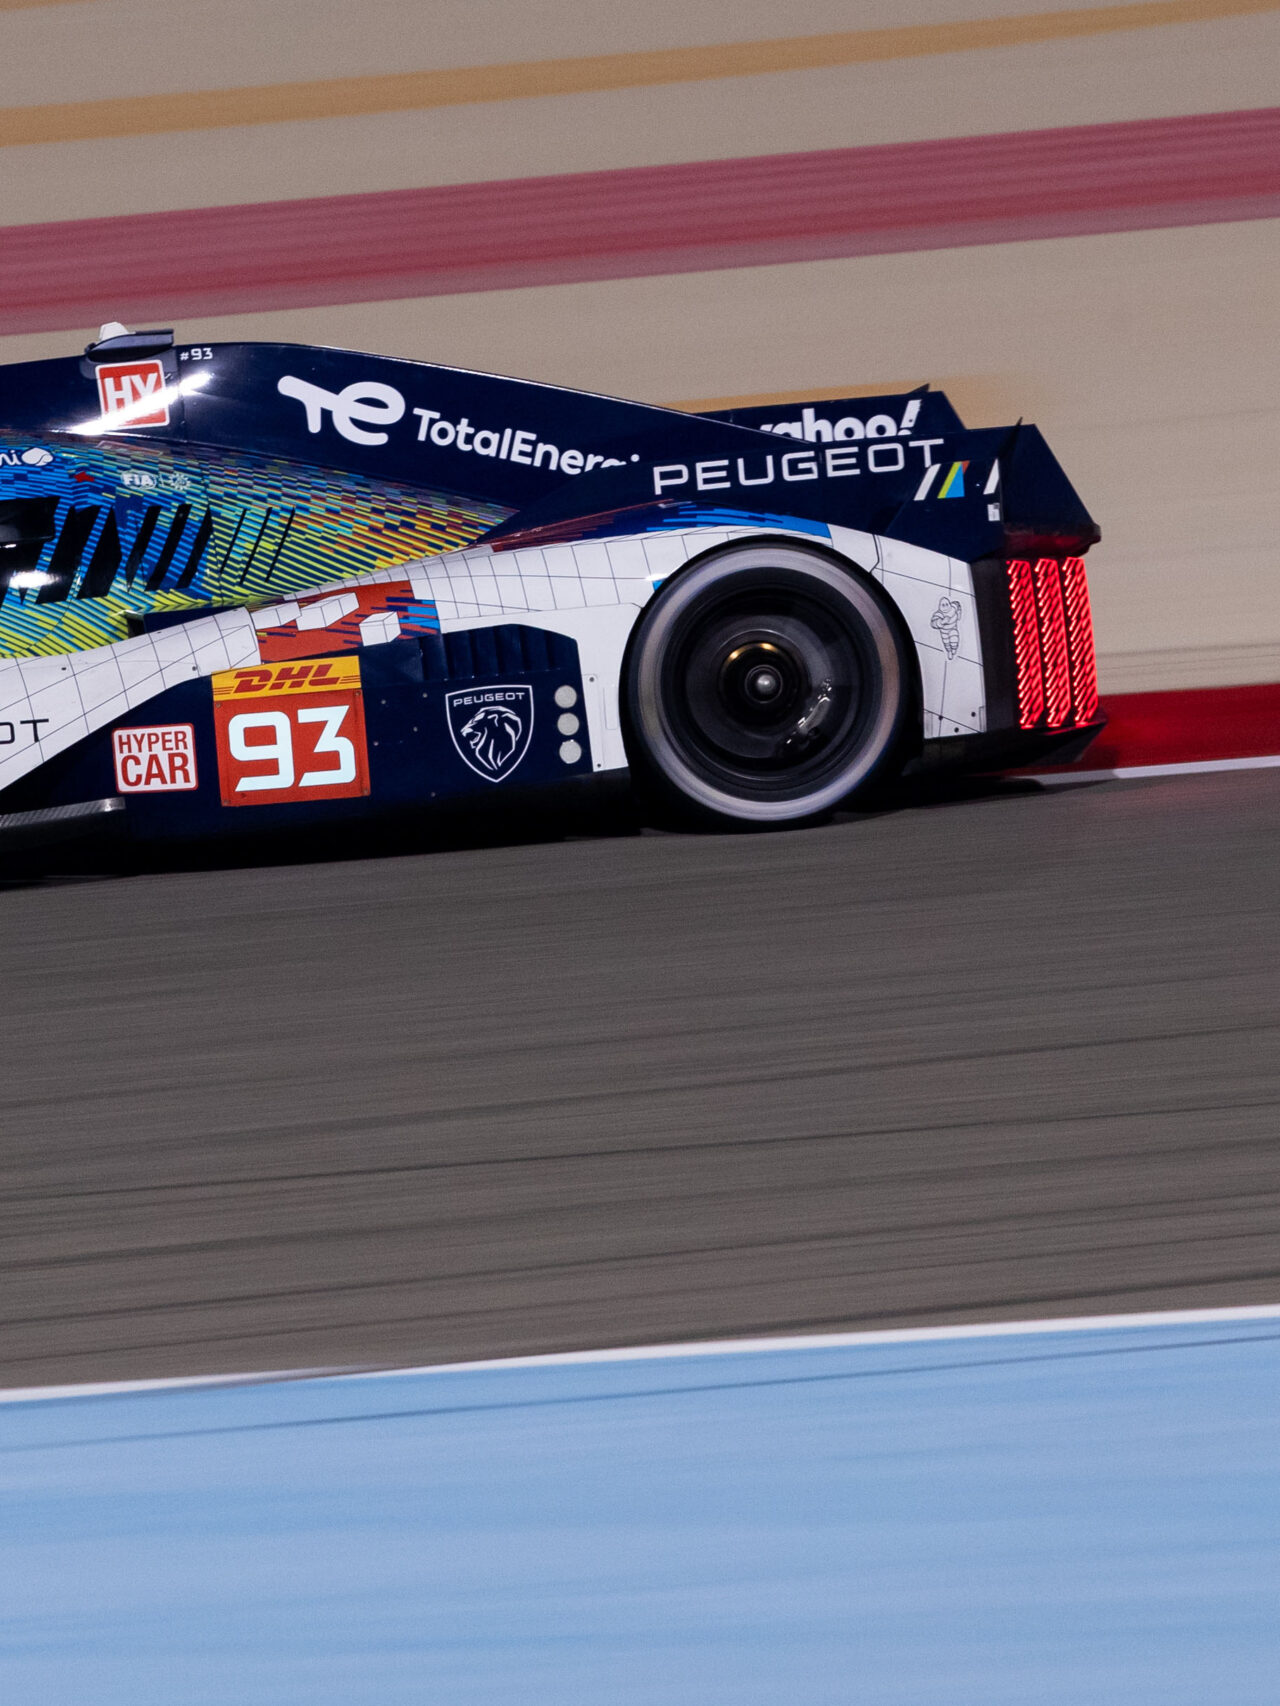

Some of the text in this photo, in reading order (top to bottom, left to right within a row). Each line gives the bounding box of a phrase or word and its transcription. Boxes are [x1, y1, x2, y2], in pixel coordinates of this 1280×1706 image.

[179, 347, 214, 361] #93
[103, 372, 159, 415] HY
[760, 399, 922, 444] ahoo!
[413, 407, 641, 475] TotalEner
[122, 472, 155, 487] FIA
[652, 437, 945, 496] PEUGEOT
[233, 663, 341, 694] DHL
[452, 692, 526, 707] PEUGEOT
[118, 730, 189, 754] HYPER
[228, 704, 357, 793] 93
[120, 751, 191, 788] CAR
